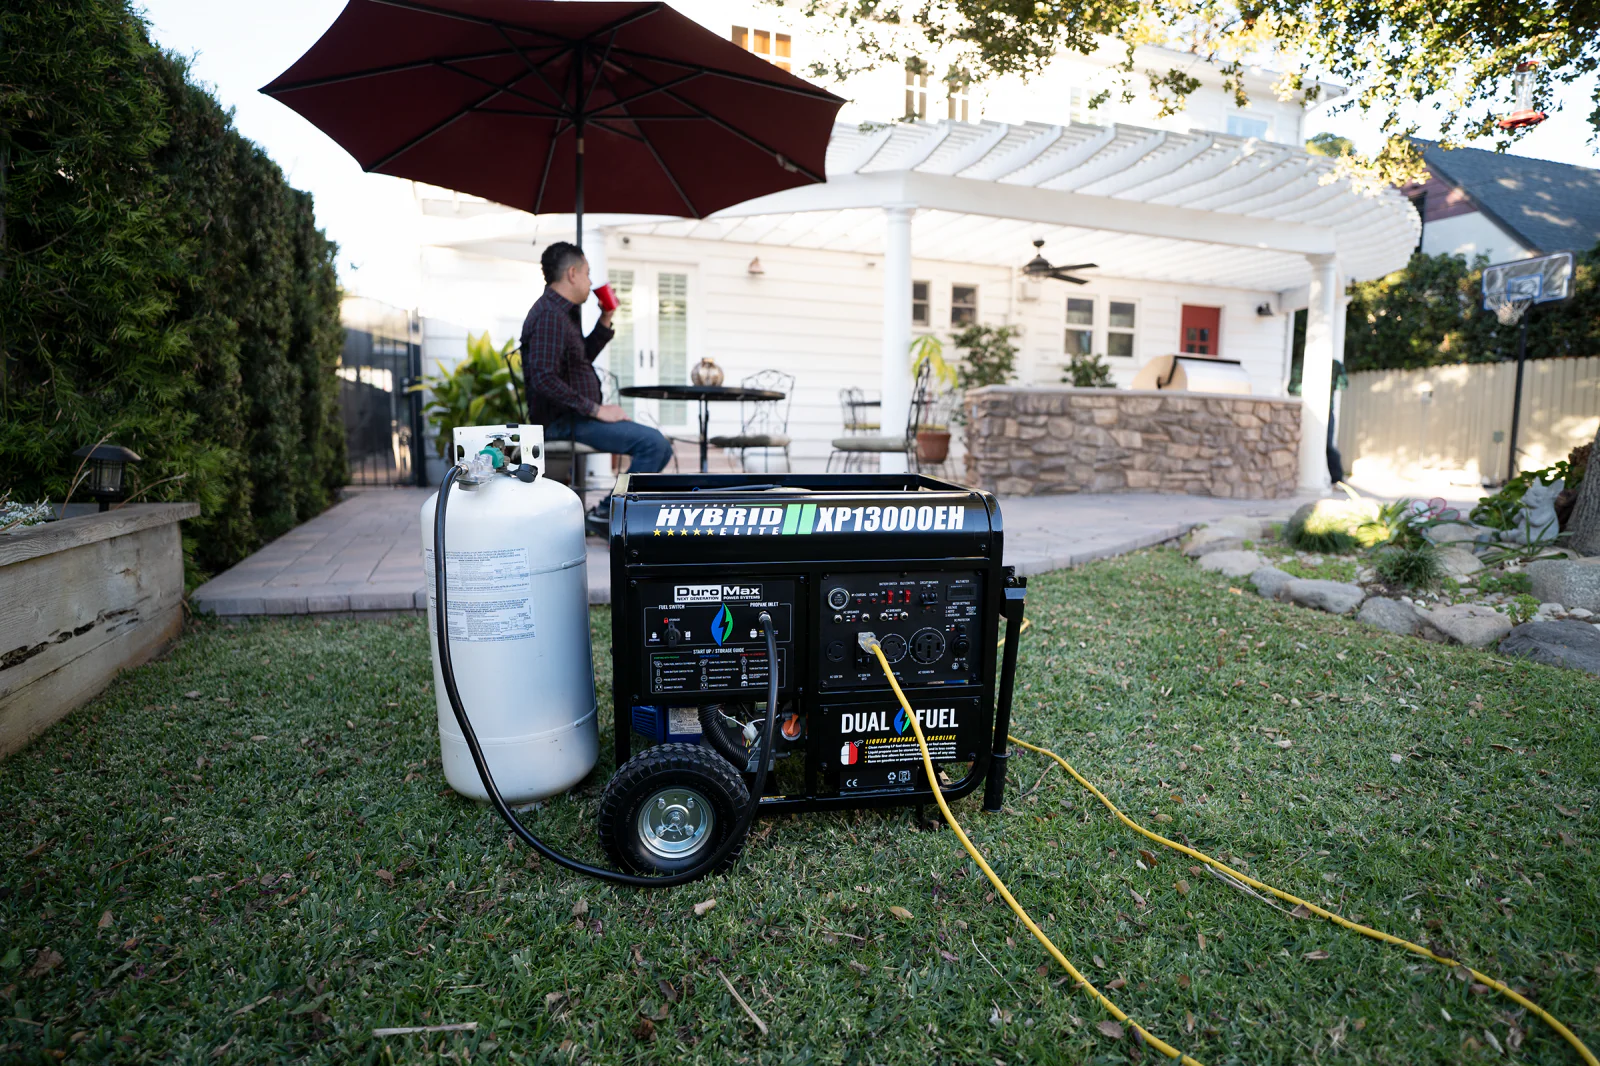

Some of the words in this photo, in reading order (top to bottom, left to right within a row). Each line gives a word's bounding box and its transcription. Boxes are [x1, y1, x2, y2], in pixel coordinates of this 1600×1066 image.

[656, 508, 783, 526] HYBRID
[816, 506, 964, 532] XP13000EH
[720, 527, 780, 536] ELITE
[841, 711, 890, 734] DUAL
[916, 708, 959, 728] FUEL
